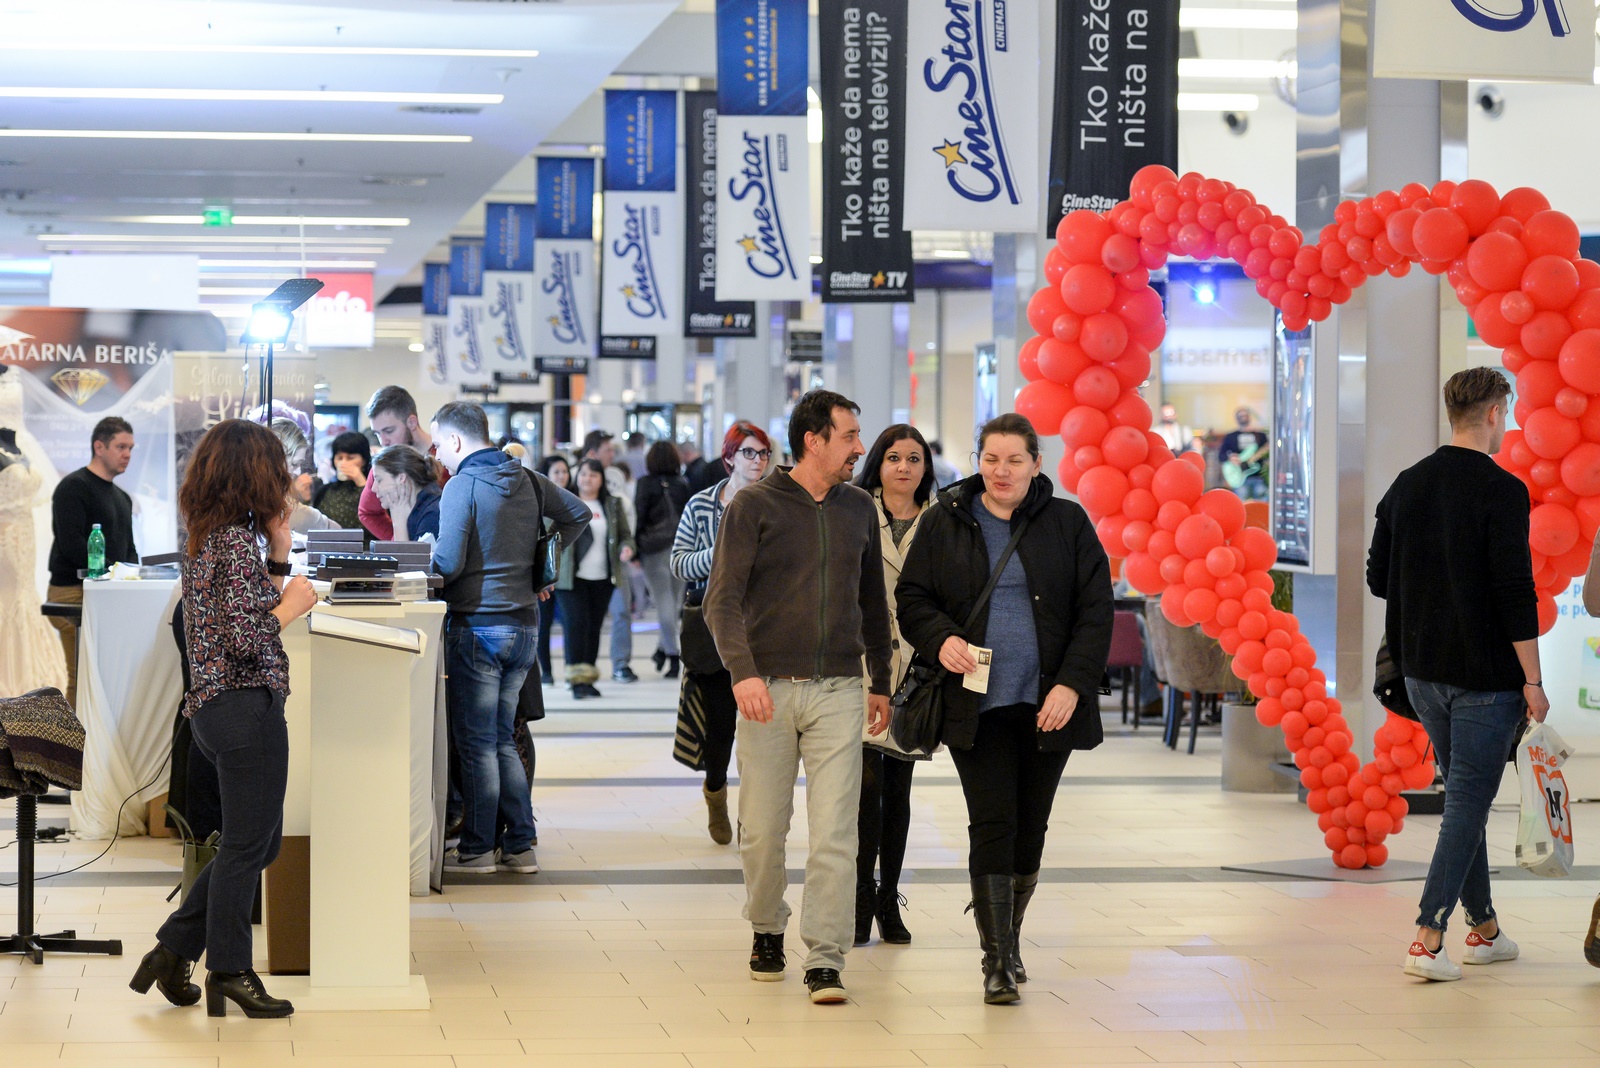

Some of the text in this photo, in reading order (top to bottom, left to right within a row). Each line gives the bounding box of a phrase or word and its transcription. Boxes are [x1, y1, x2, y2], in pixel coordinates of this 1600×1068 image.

[996, 1, 1006, 49] CINEMAS
[1118, 9, 1148, 147] ništa na
[840, 7, 863, 242] Tko kaže da nema
[866, 11, 892, 239] ništa na televiziji?
[1080, 85, 1108, 150] Tko
[699, 108, 717, 291] Tko kaže da nema
[728, 130, 785, 279] CineStar
[1062, 193, 1119, 210] CineStar
[613, 203, 657, 318] CineStar
[886, 271, 908, 288] TV
[95, 341, 171, 365] BERIŠA
